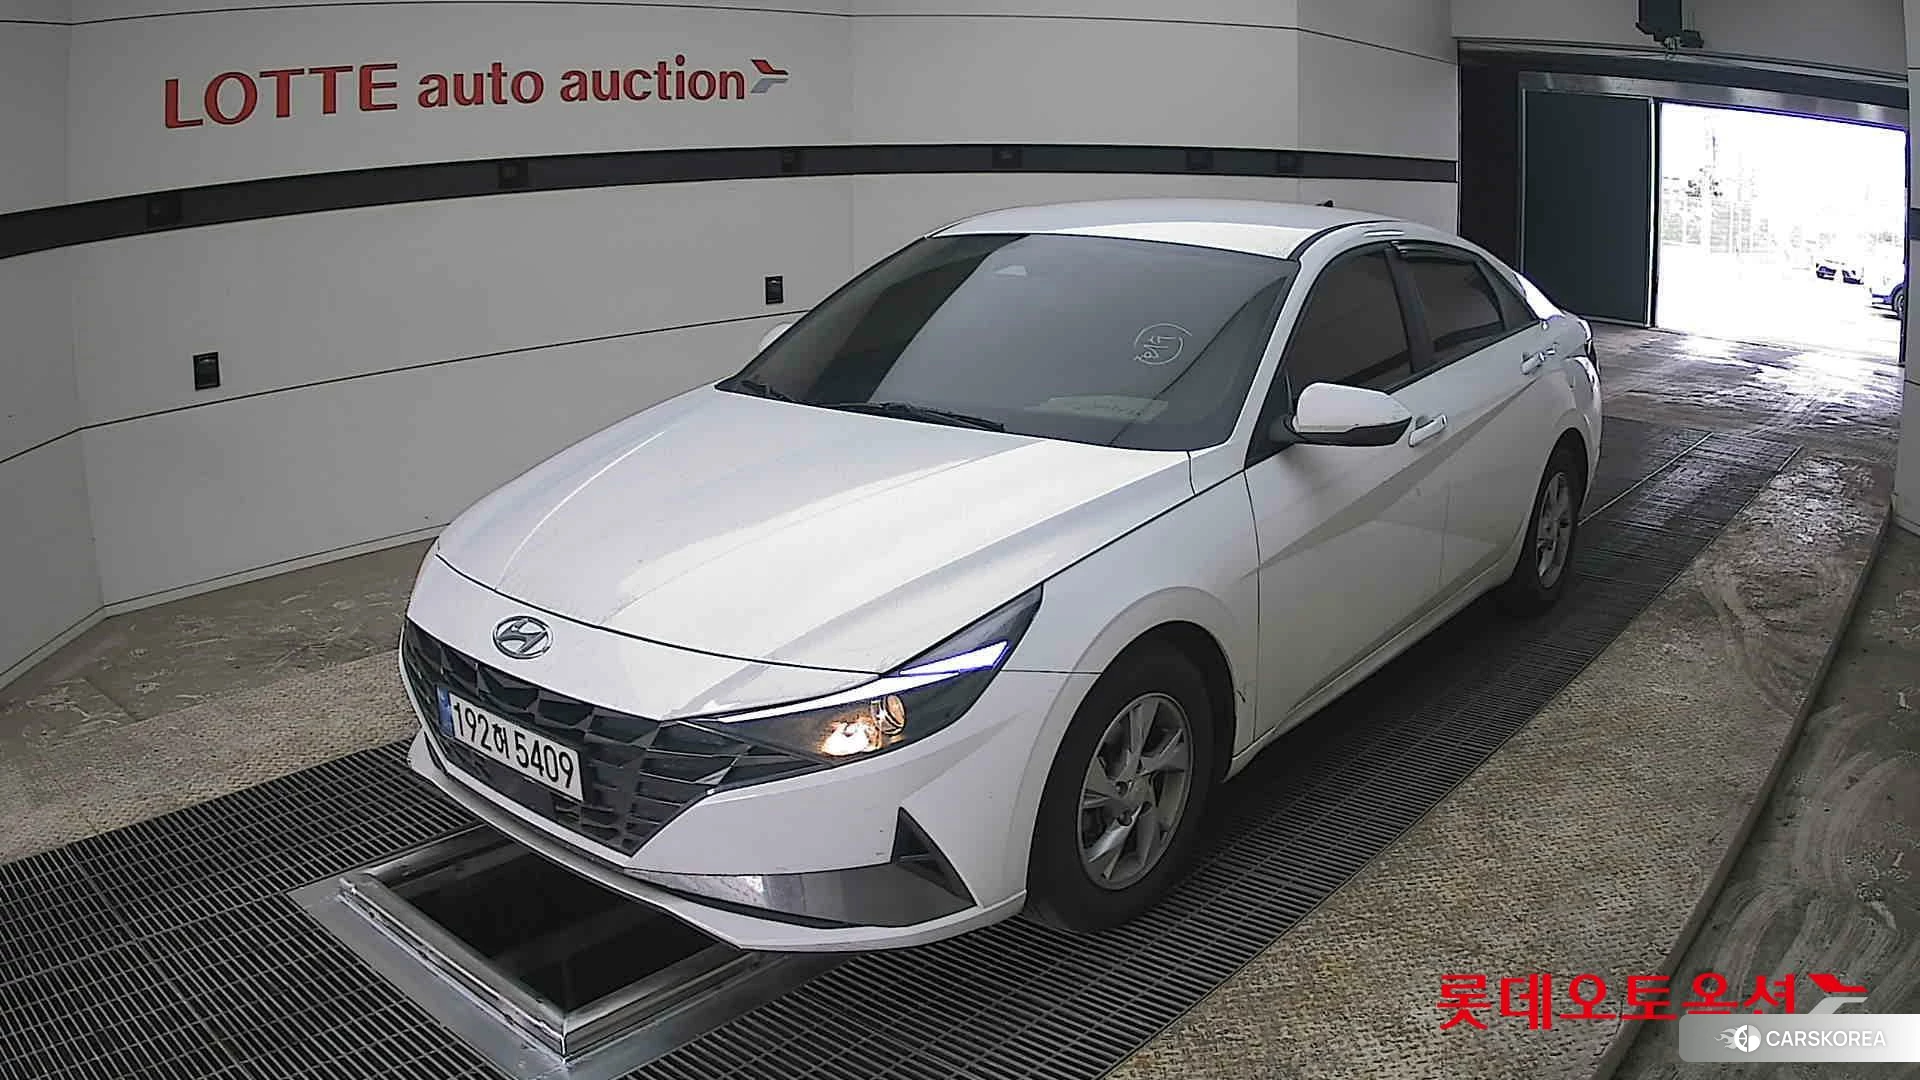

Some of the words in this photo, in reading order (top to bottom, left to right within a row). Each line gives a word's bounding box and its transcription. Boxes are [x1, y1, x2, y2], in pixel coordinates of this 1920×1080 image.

[165, 63, 398, 128] LOTTE
[418, 62, 544, 108] auto
[560, 54, 746, 103] auction
[514, 731, 573, 788] 5409
